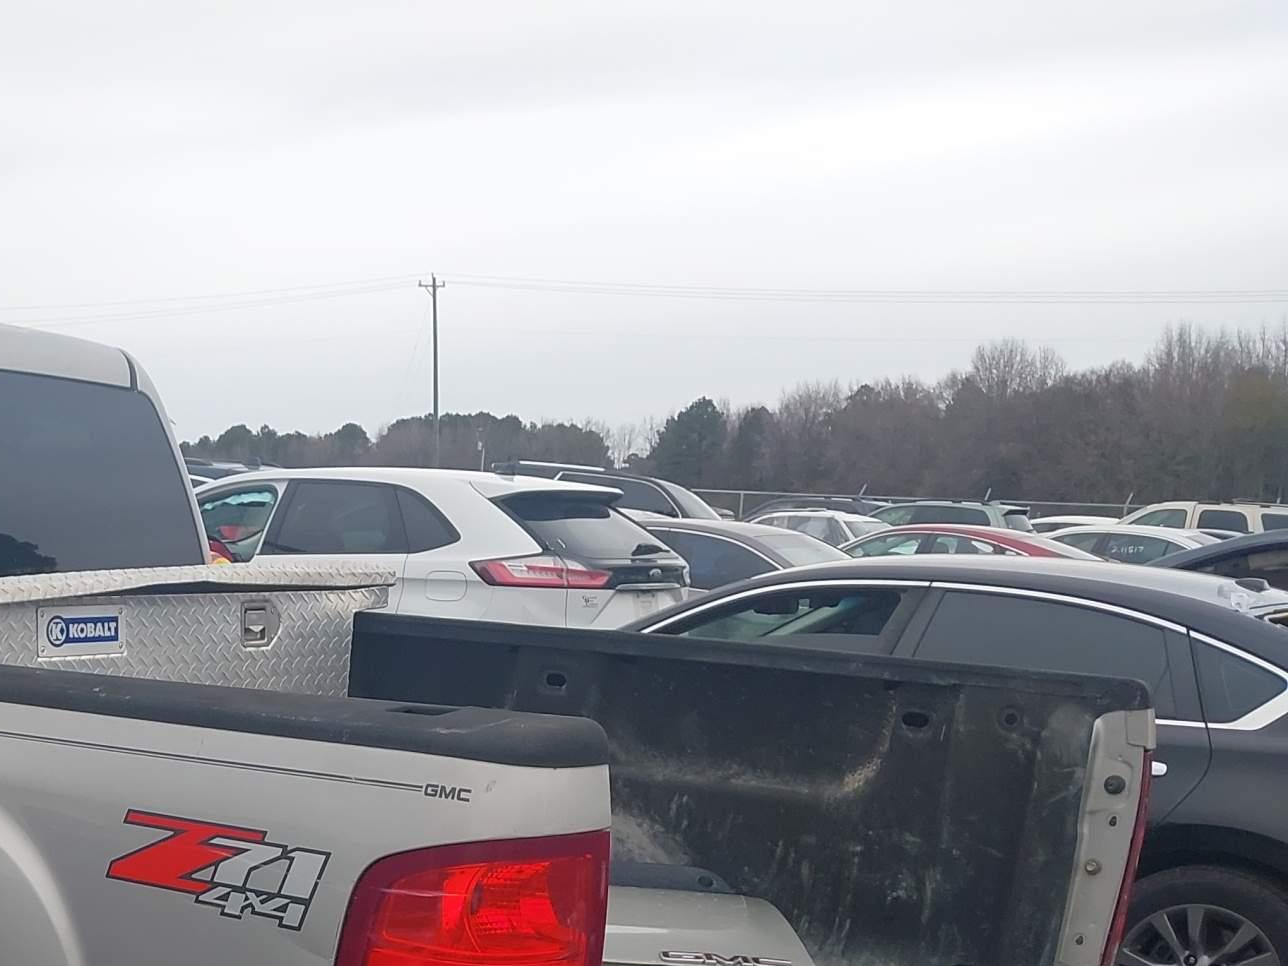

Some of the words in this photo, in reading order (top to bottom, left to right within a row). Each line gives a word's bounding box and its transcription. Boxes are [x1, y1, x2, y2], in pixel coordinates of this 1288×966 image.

[69, 621, 117, 638] KOBALT
[423, 783, 473, 803] GMC
[105, 808, 332, 900] Z71
